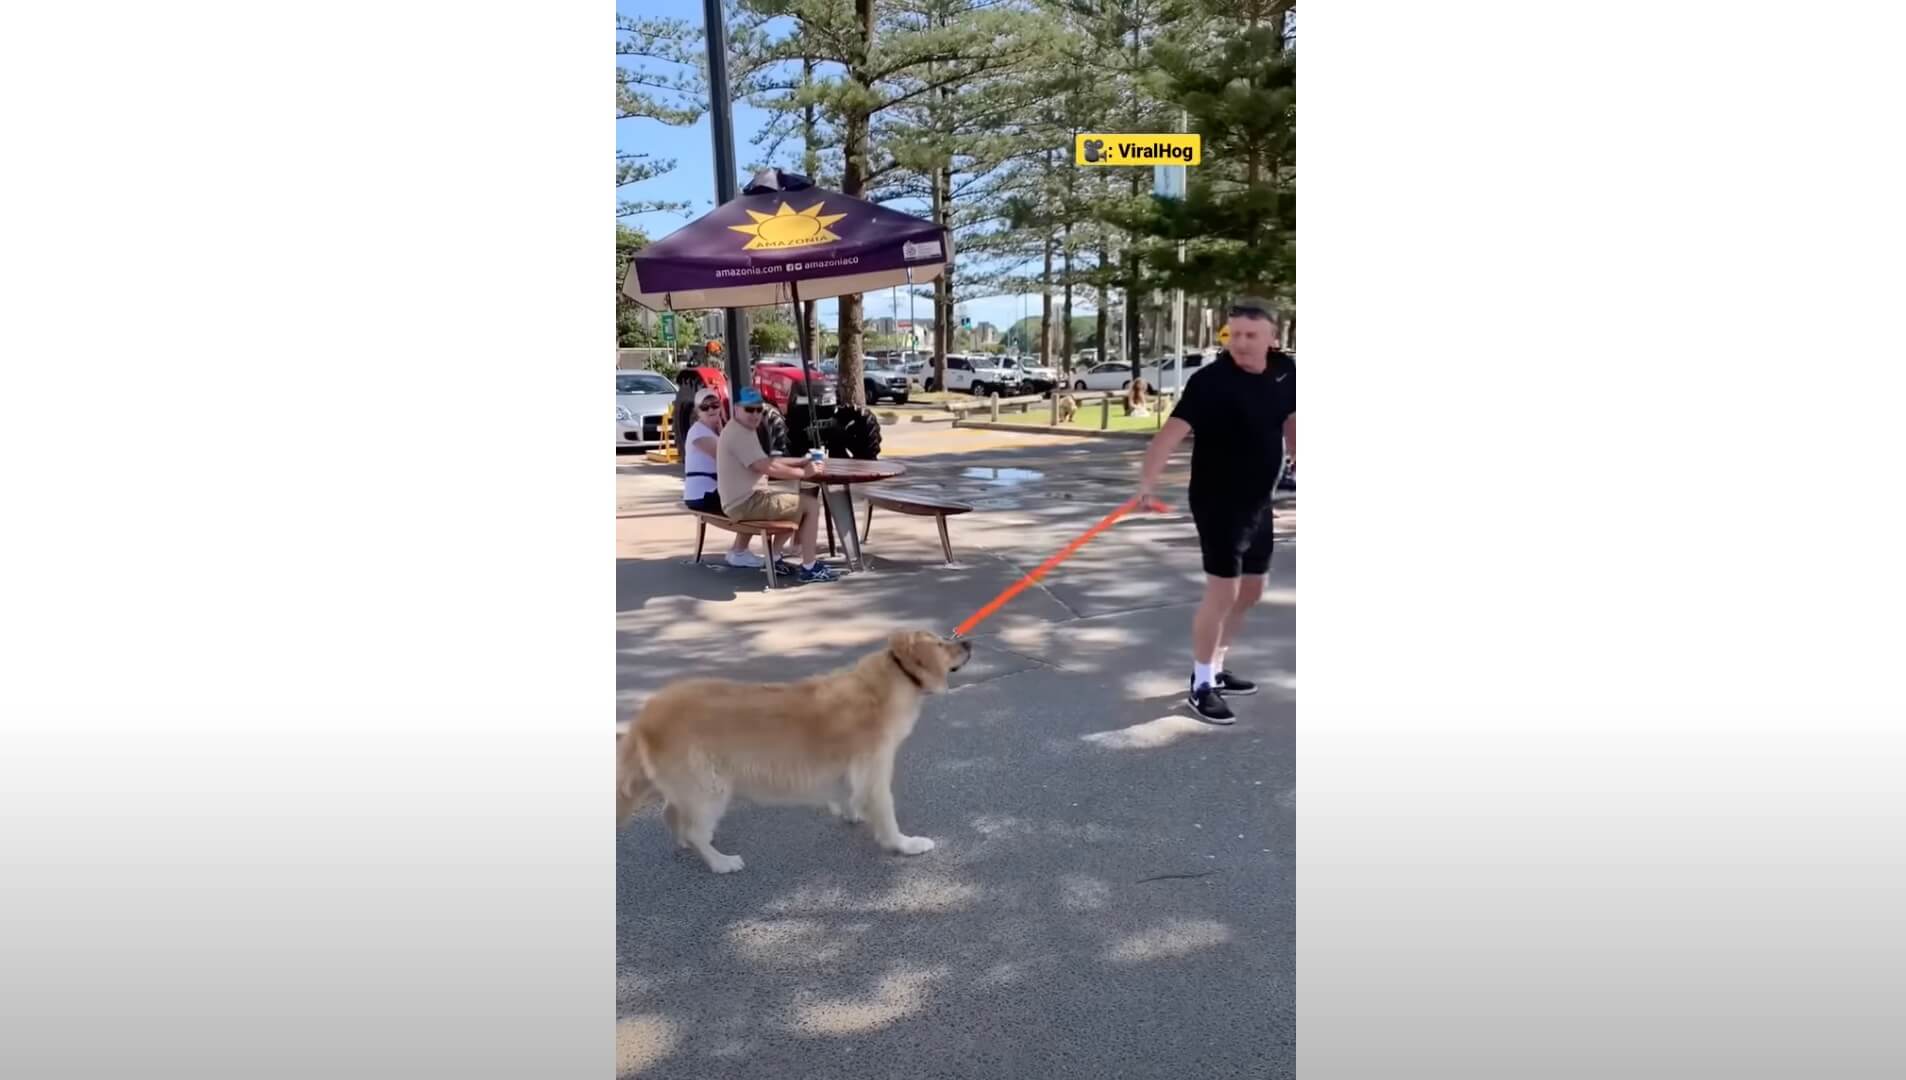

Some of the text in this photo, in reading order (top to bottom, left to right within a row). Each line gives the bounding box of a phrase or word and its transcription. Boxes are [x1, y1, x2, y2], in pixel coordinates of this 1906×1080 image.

[756, 235, 829, 248] AMAZONIA
[715, 256, 859, 278] amazonia.com amazoniaco
